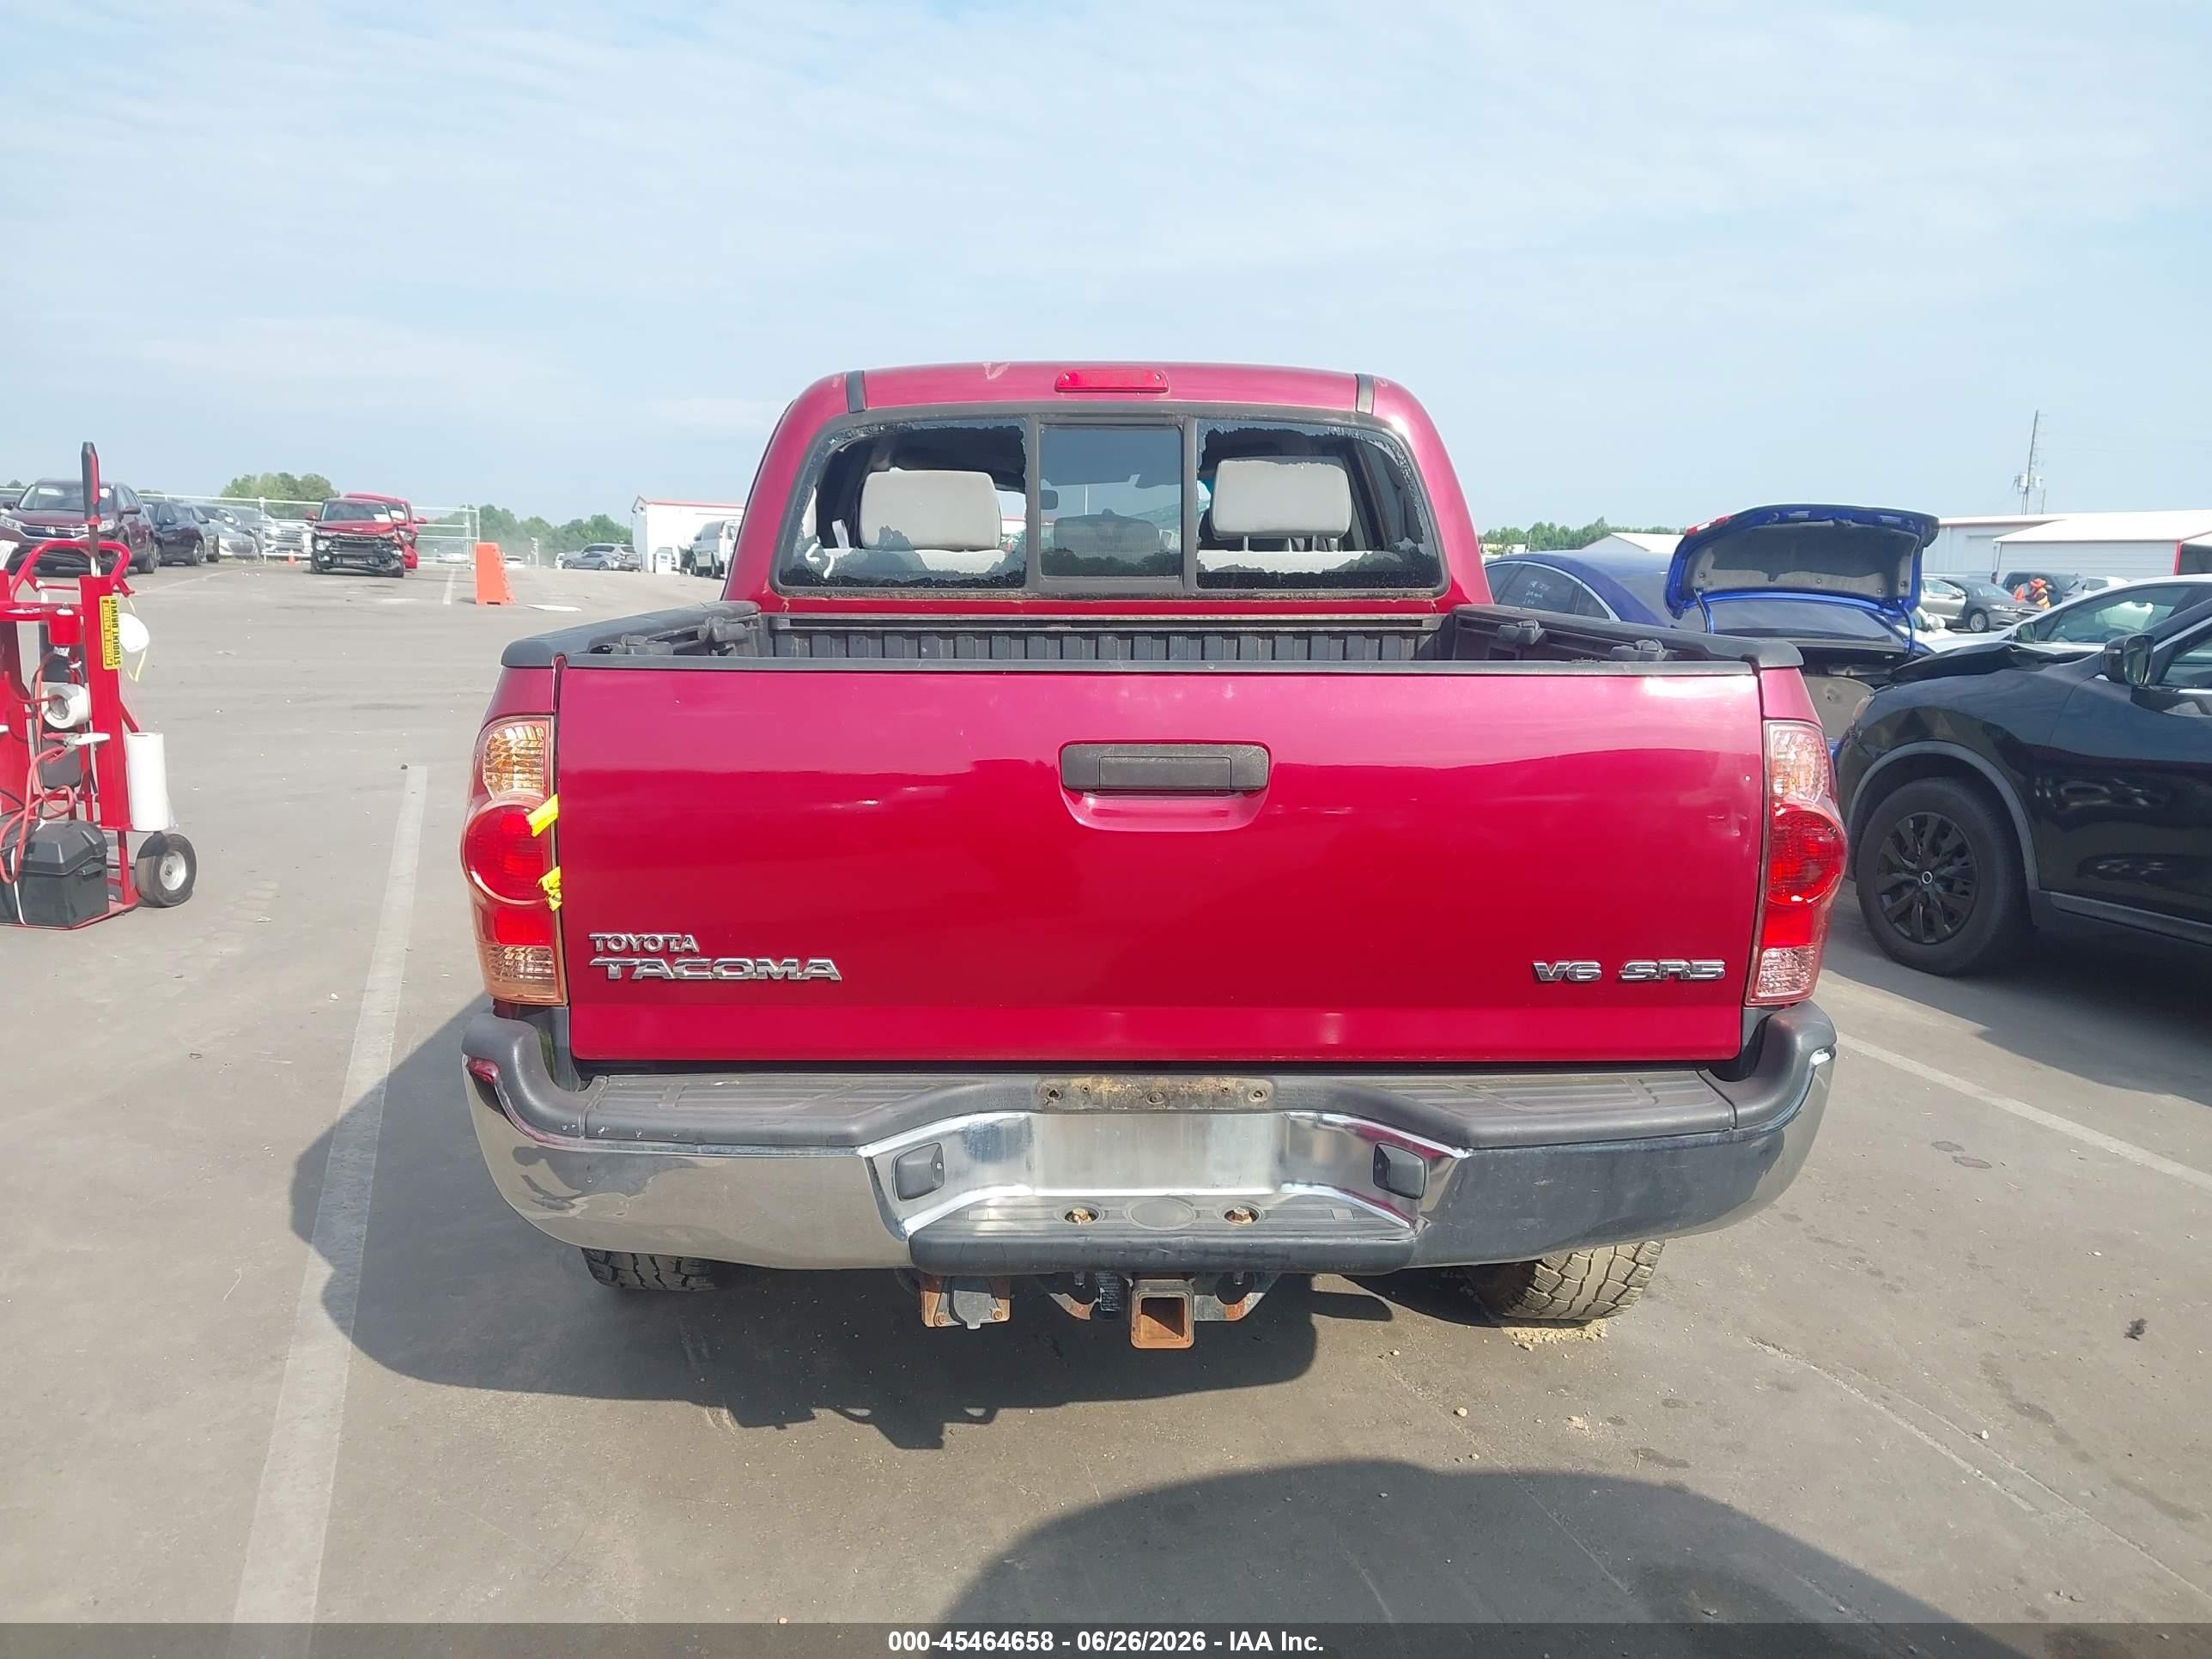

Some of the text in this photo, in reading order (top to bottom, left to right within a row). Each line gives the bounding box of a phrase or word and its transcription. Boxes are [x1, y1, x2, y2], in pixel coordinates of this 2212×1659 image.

[112, 631, 121, 665] STUDENT
[589, 933, 699, 952] TOYOTA
[589, 957, 842, 981] TACOMA
[1533, 960, 1726, 981] V6 SR5
